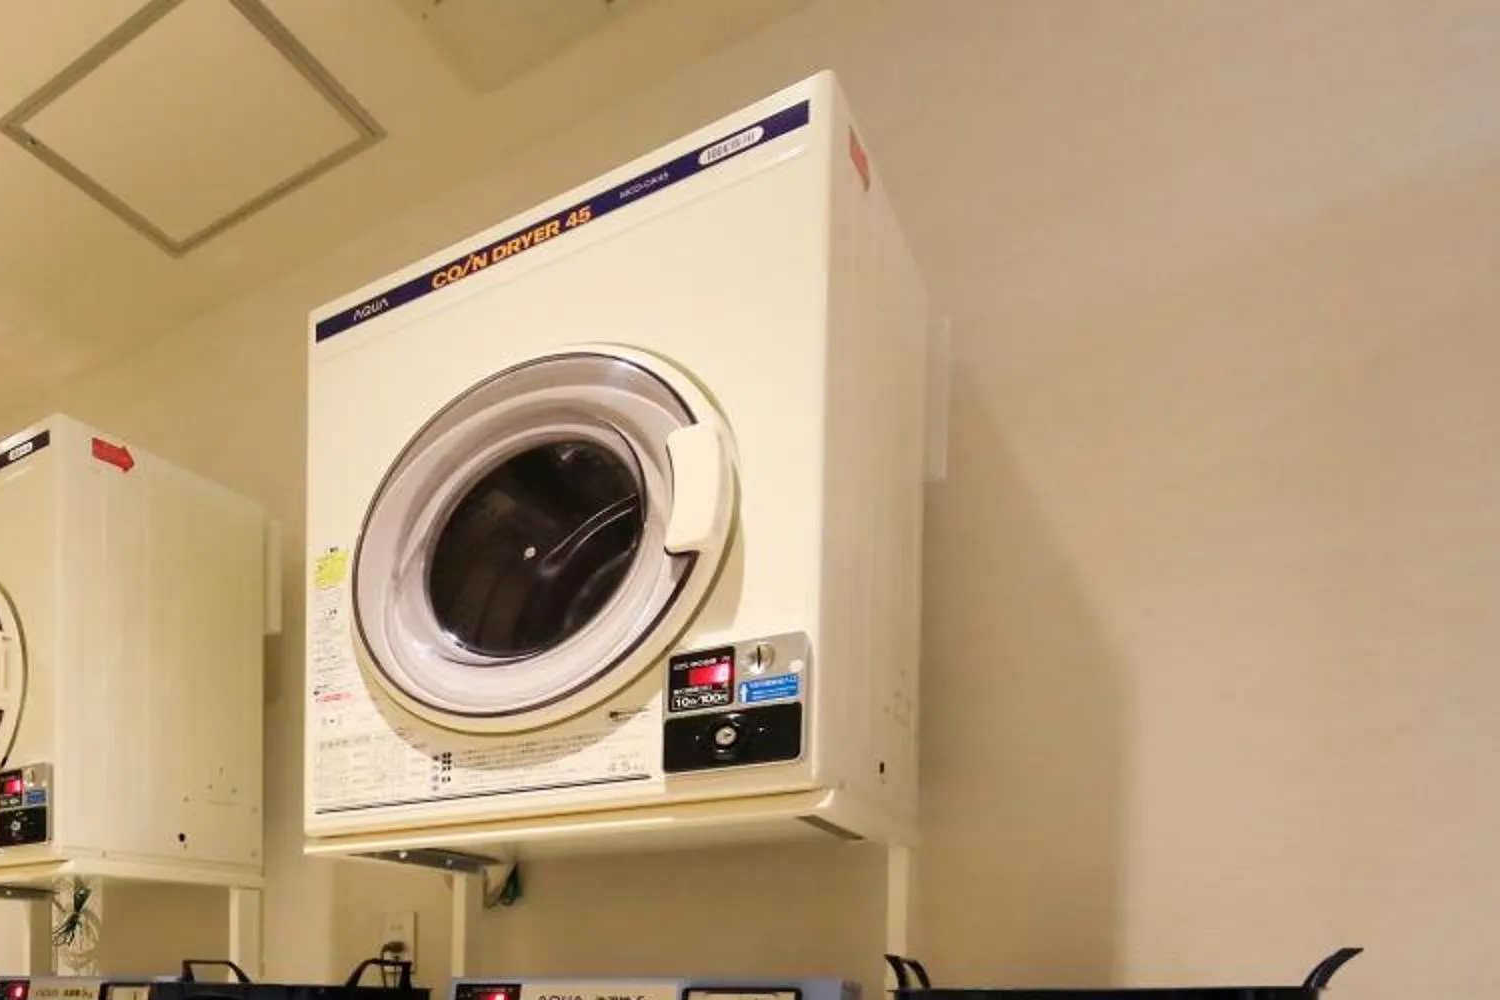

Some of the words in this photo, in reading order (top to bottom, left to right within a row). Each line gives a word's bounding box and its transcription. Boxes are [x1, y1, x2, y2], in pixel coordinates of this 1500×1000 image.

[353, 297, 389, 321] AQUA
[491, 219, 562, 263] DRYER
[565, 205, 592, 228] 45
